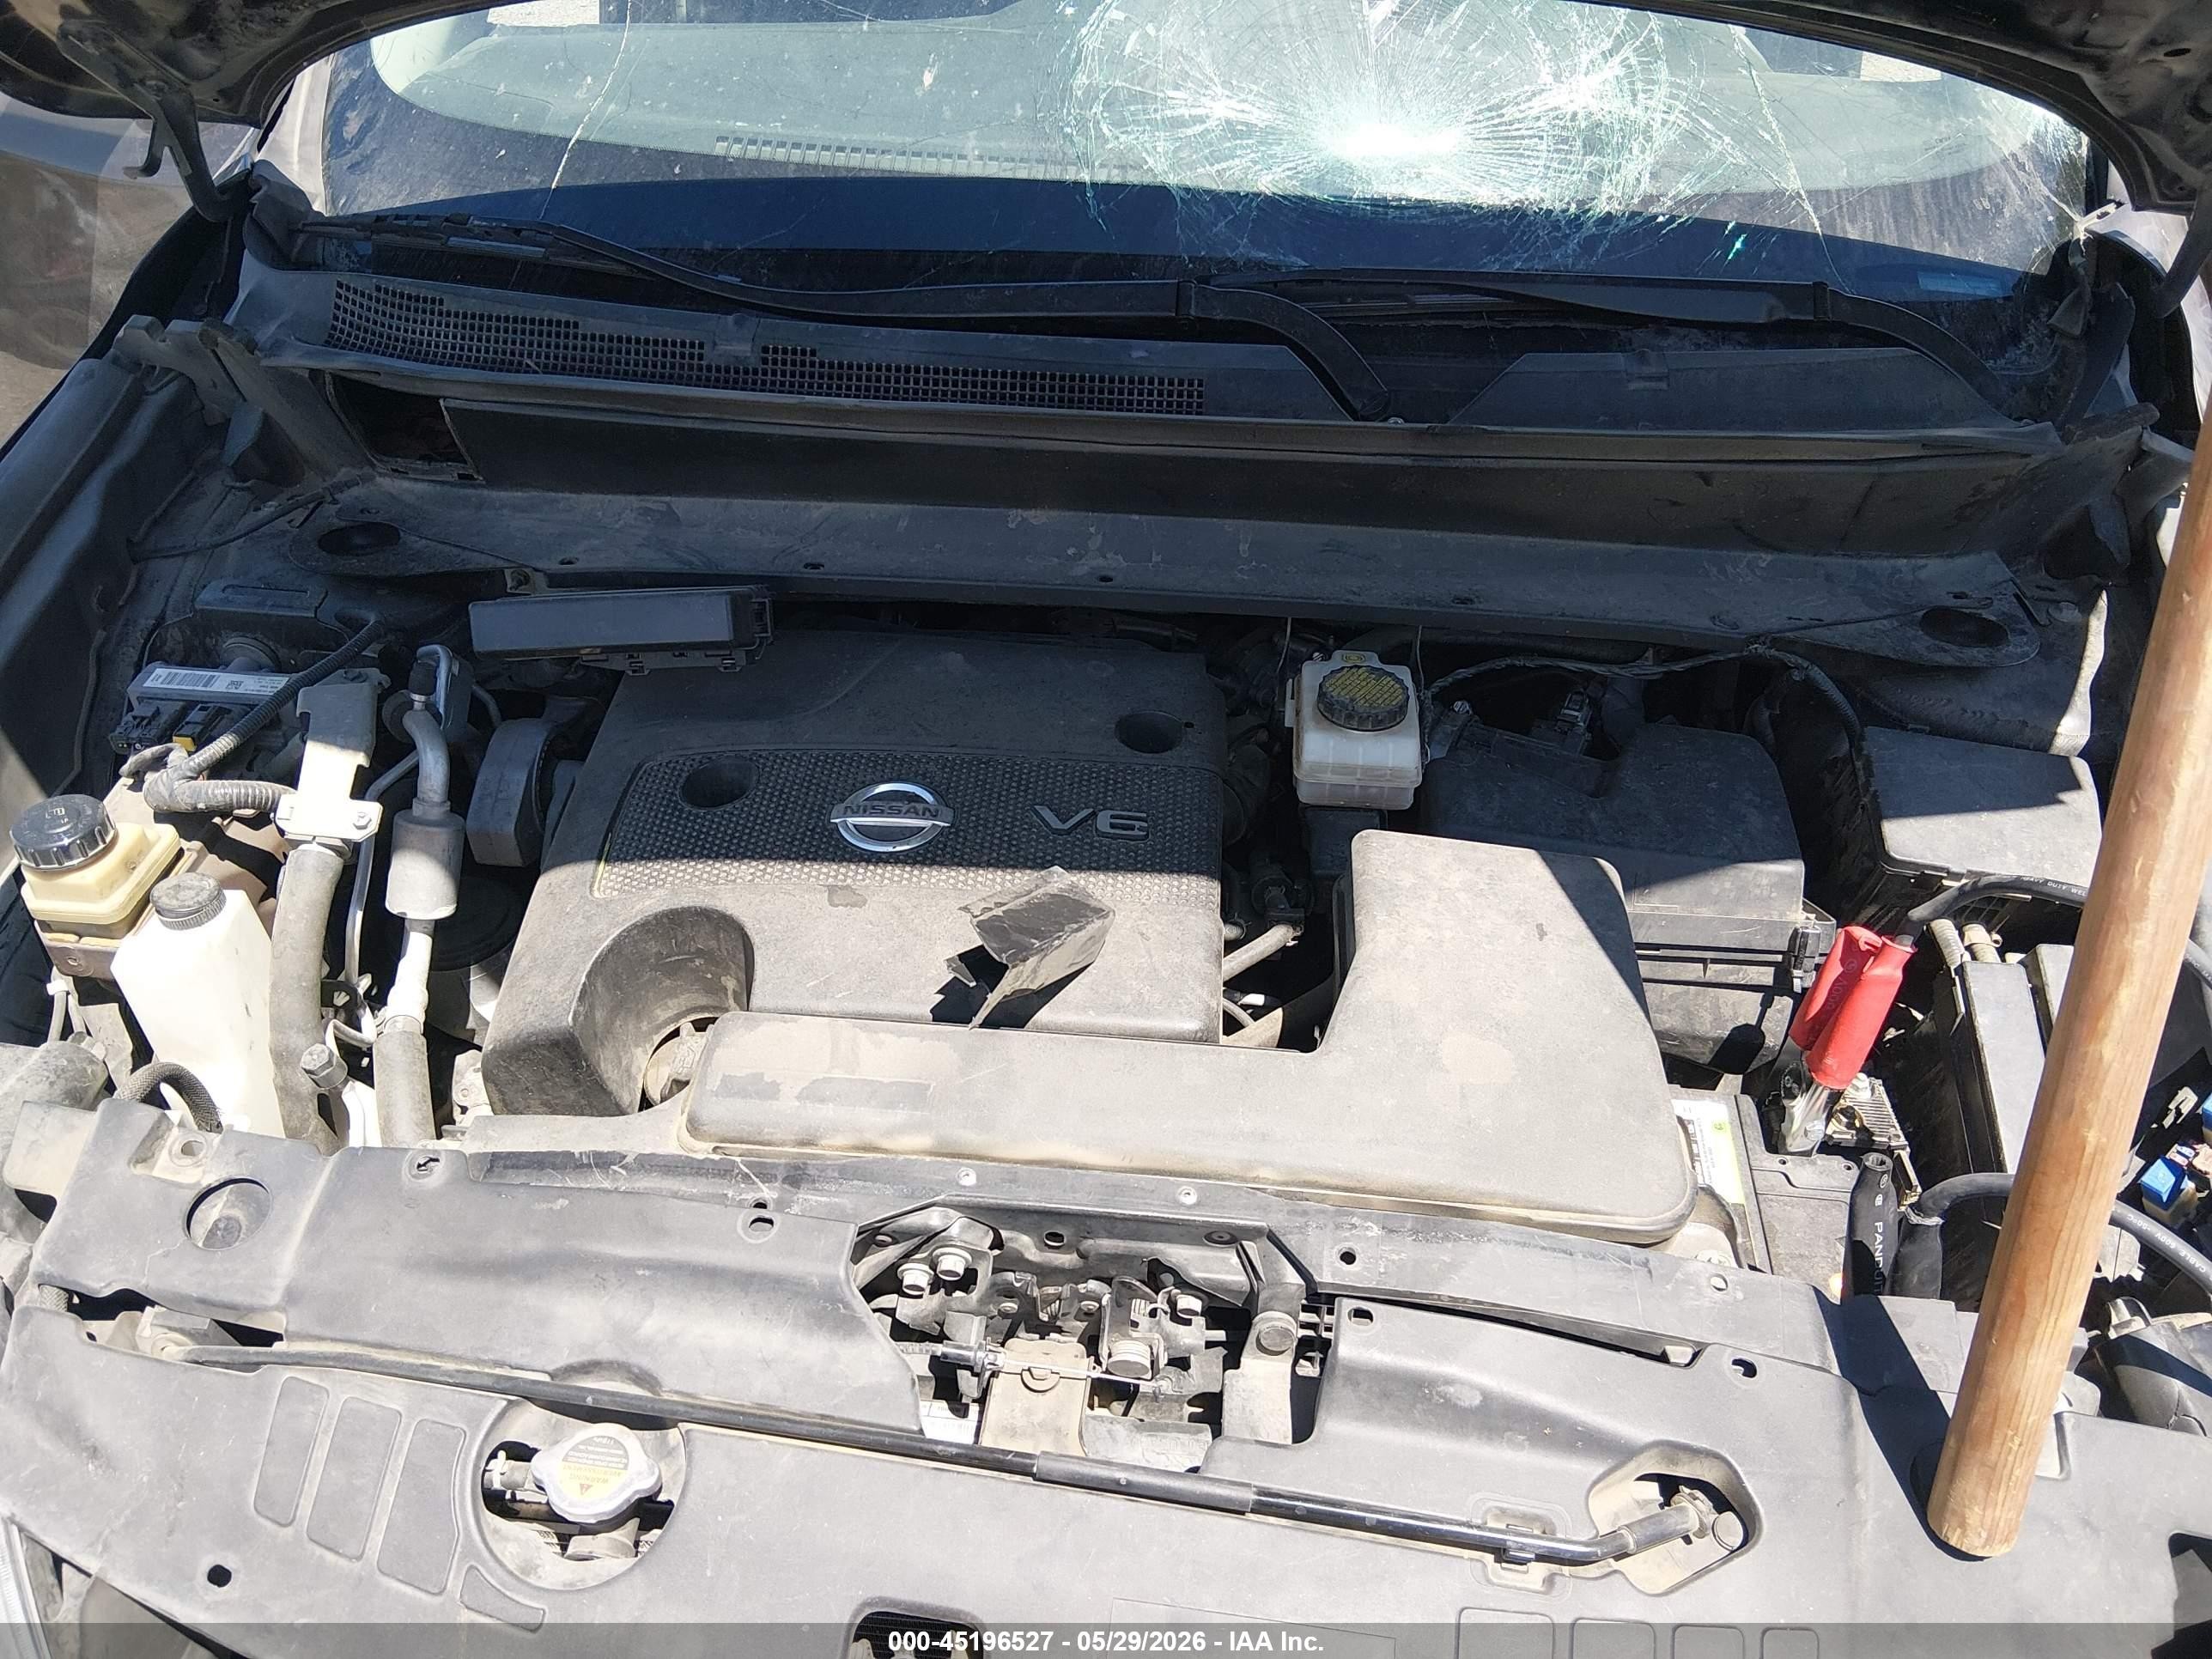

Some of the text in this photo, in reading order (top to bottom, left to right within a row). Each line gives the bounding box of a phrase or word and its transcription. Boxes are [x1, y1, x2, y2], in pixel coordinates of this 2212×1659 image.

[842, 804, 940, 818] NISSAN
[1032, 805, 1149, 838] V6
[2020, 875, 2045, 884] HEAVY
[2047, 881, 2068, 890] DUTY
[1874, 1221, 1884, 1294] PANDUIT
[2178, 1249, 2206, 1273] CABLE
[568, 1472, 610, 1485] WARNING
